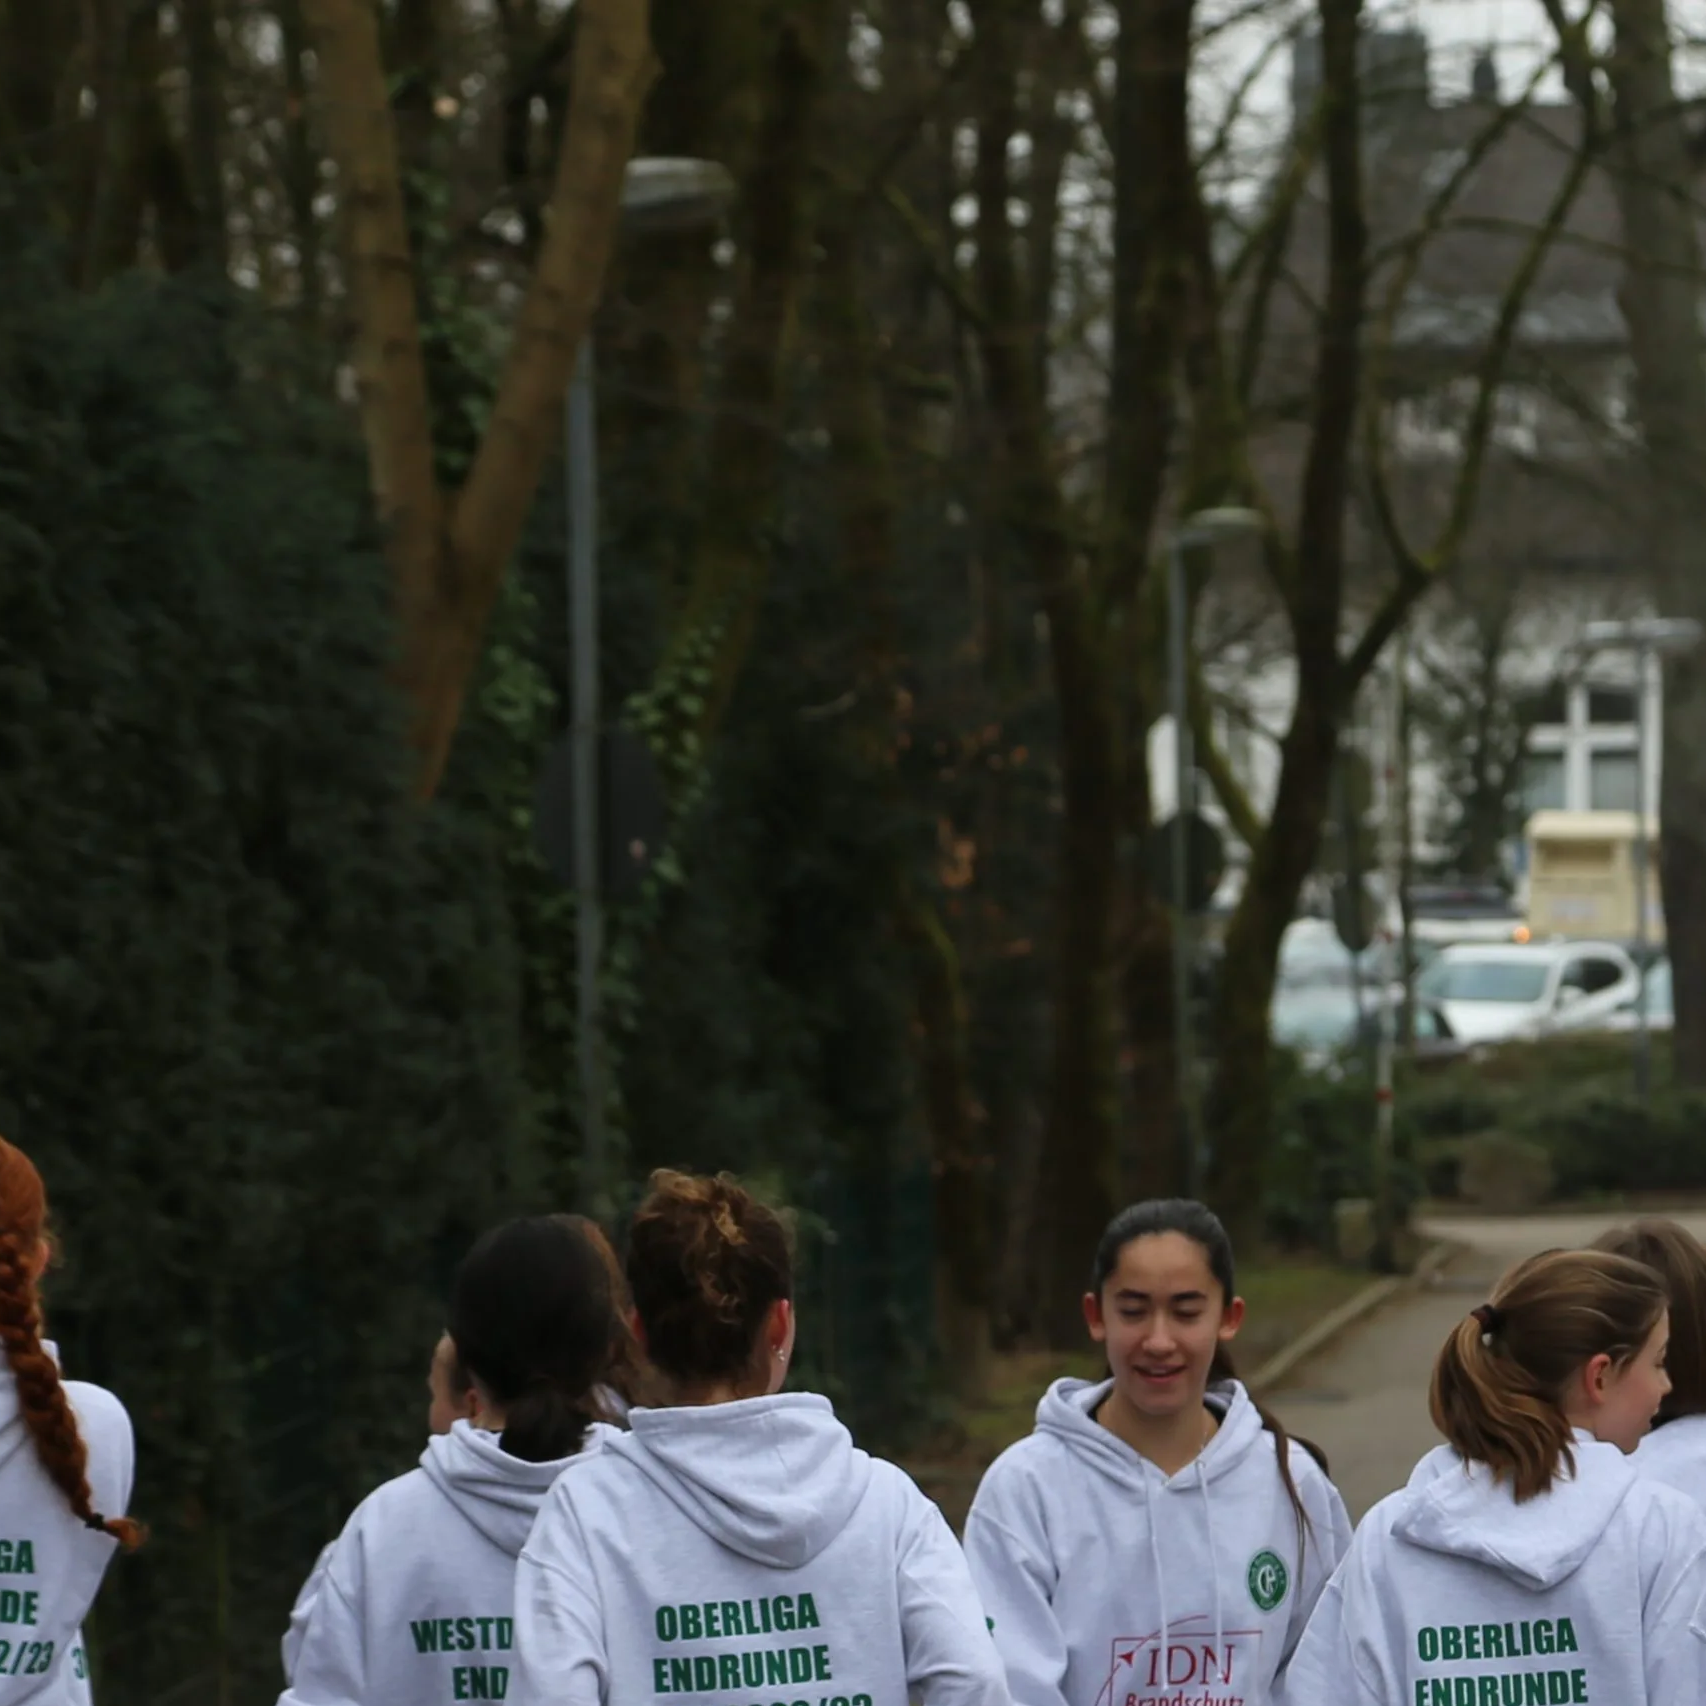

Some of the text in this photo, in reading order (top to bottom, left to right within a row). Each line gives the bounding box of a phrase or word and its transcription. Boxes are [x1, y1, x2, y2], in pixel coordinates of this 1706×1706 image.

[655, 1592, 820, 1642] OBERLIGA
[1417, 1617, 1579, 1662] OBERLIGA
[653, 1644, 833, 1694] ENDRUNDE
[1145, 1643, 1237, 1687] IDN
